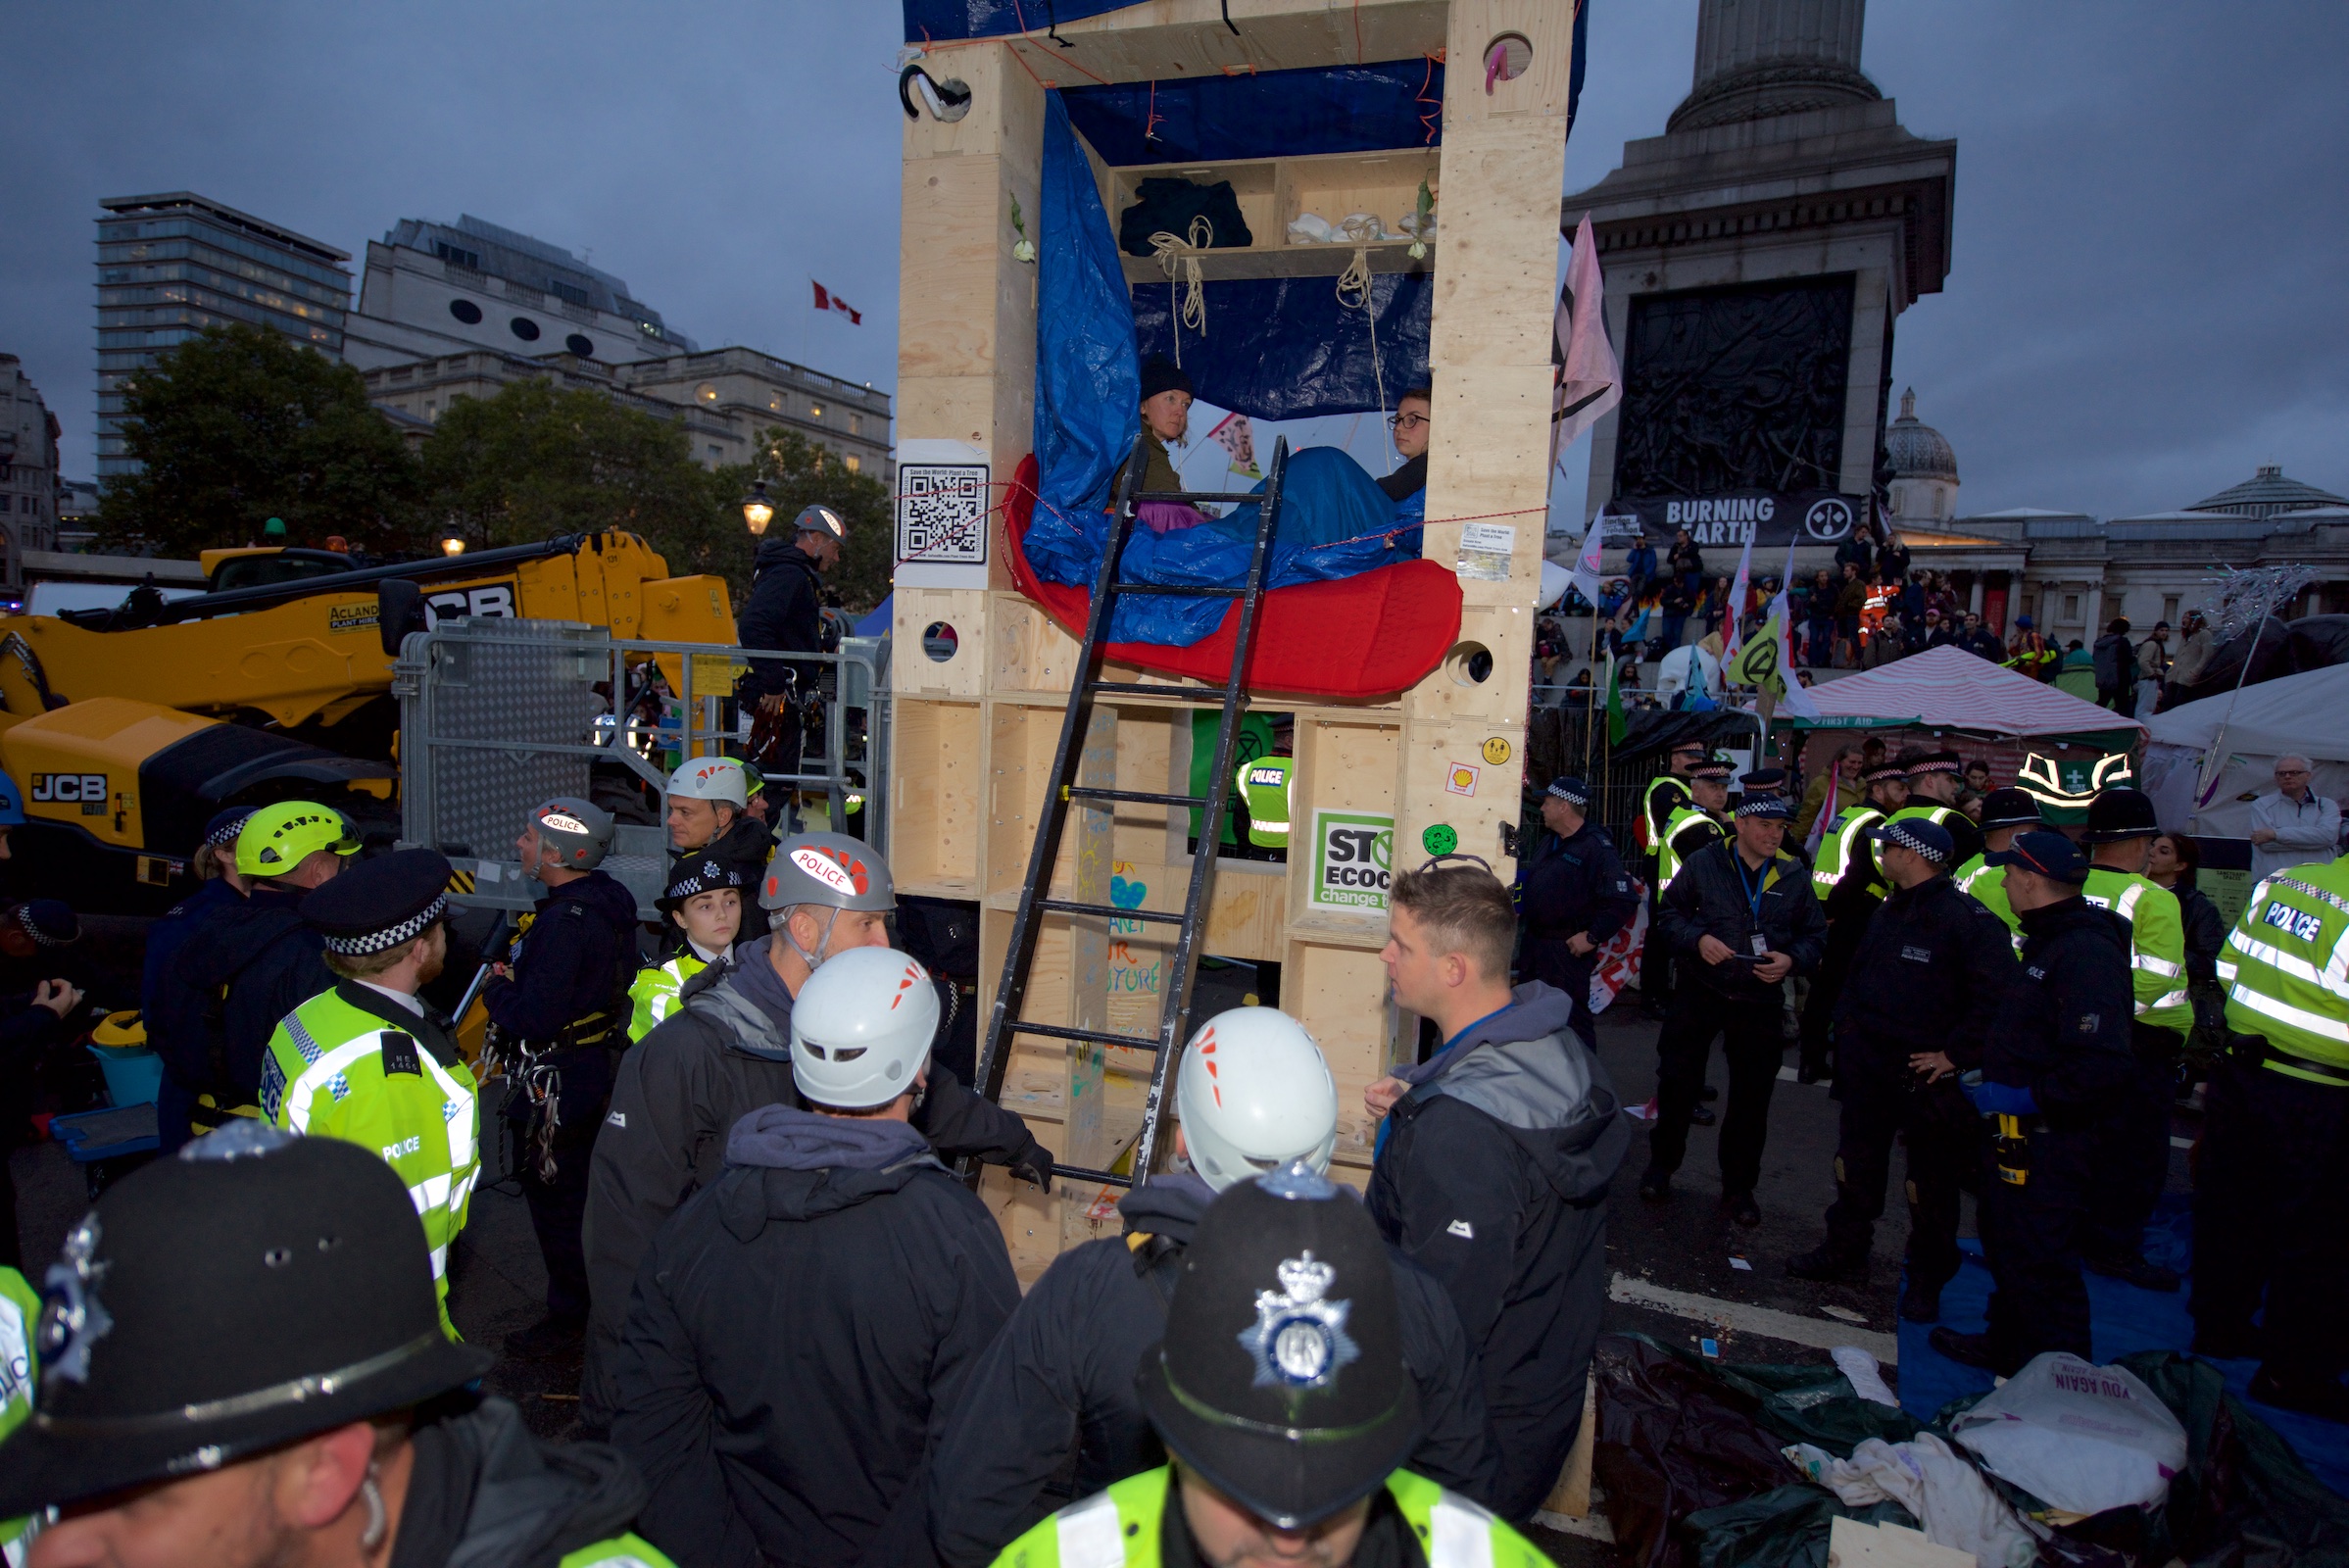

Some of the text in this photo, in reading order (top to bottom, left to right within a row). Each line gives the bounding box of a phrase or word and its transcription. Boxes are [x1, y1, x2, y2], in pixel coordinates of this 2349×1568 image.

[1666, 497, 1775, 524] BURNING
[902, 519, 907, 528] OF
[1602, 515, 1631, 526] tinction
[1606, 524, 1638, 534] rebellion
[329, 605, 378, 620] ACLAND
[423, 589, 515, 633] CB
[1822, 716, 1873, 725] FIRST AID
[1249, 769, 1282, 785] POLICE
[33, 775, 107, 802] JCB
[547, 816, 580, 831] POLICE
[799, 853, 846, 887] POLICE
[1320, 889, 1378, 906] change
[2264, 902, 2322, 942] POLICE
[382, 1136, 419, 1161] POLICE
[2101, 1381, 2129, 1399] YOU
